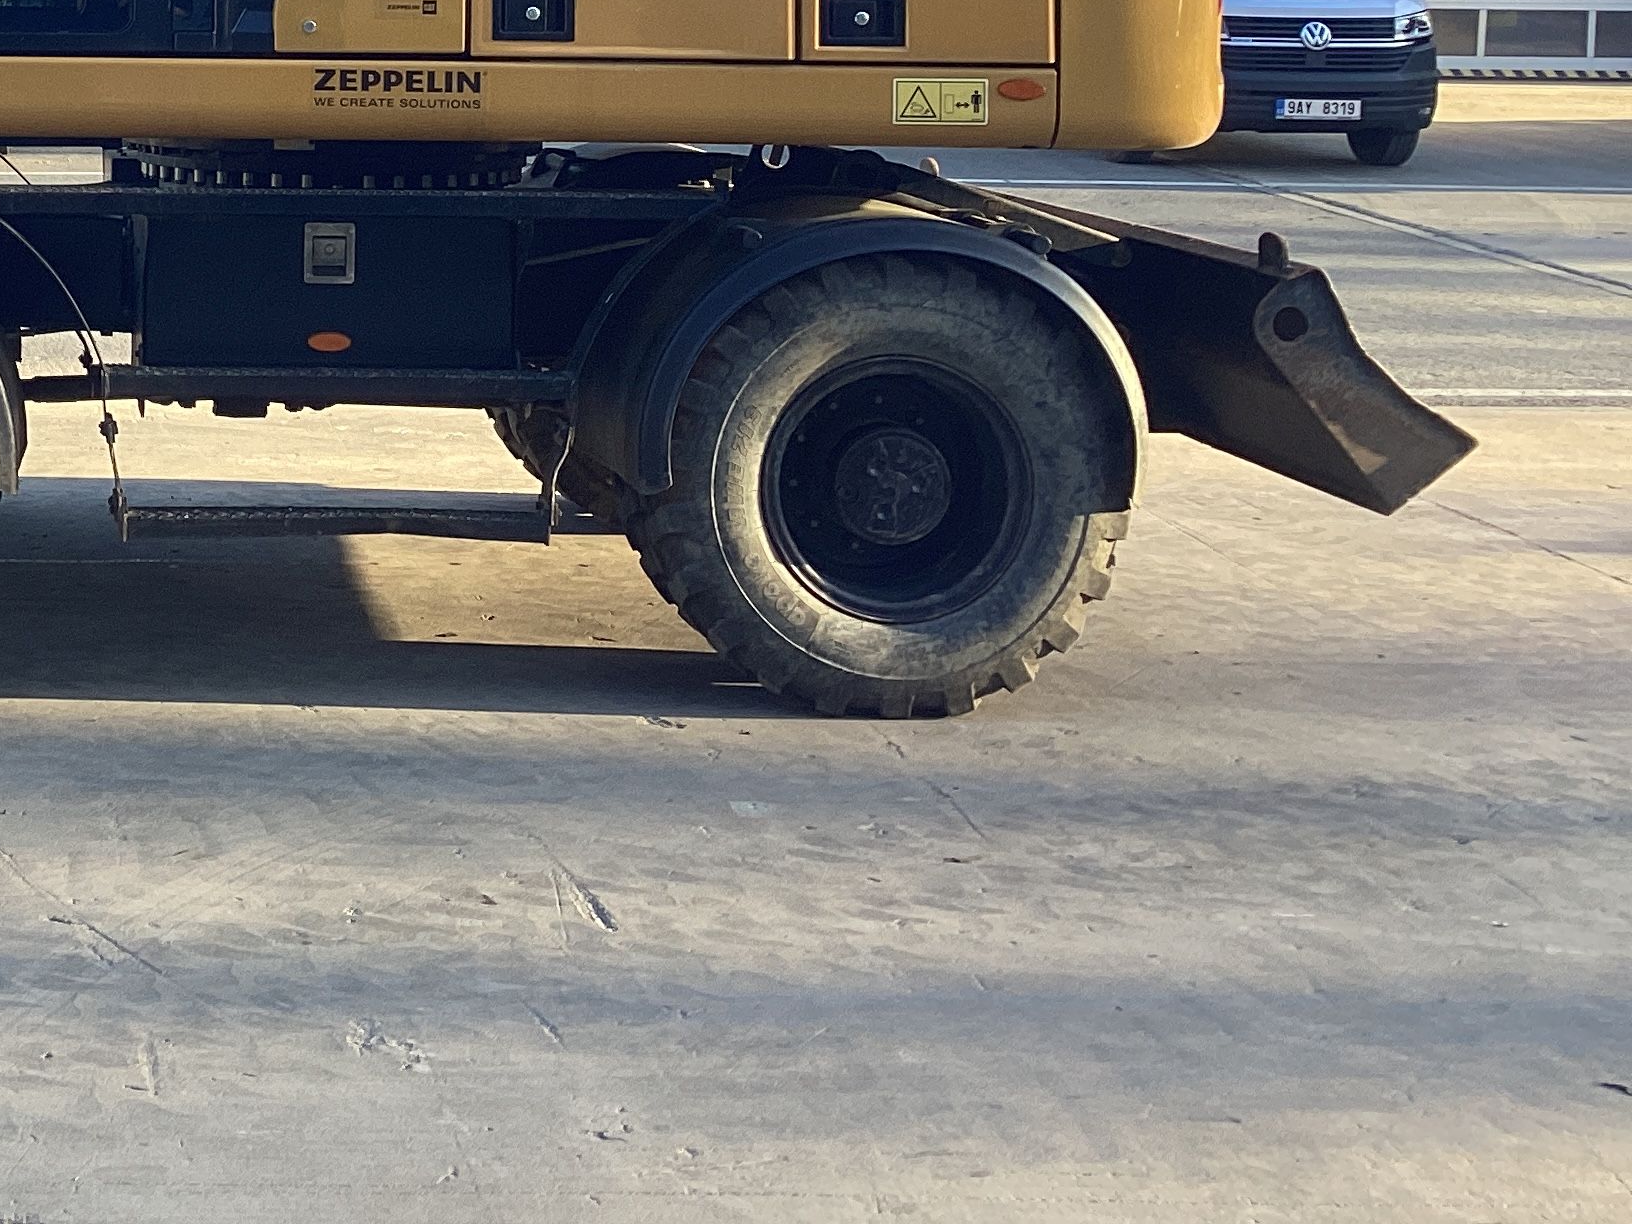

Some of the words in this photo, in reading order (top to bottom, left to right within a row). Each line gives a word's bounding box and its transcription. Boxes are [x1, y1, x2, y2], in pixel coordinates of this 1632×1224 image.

[314, 69, 481, 93] ZEPPELIN
[314, 97, 335, 107] WE
[340, 98, 394, 108] CREATE
[399, 98, 481, 109] SOLUTIONS
[1288, 101, 1312, 114] 9AY
[1323, 102, 1355, 115] 8319
